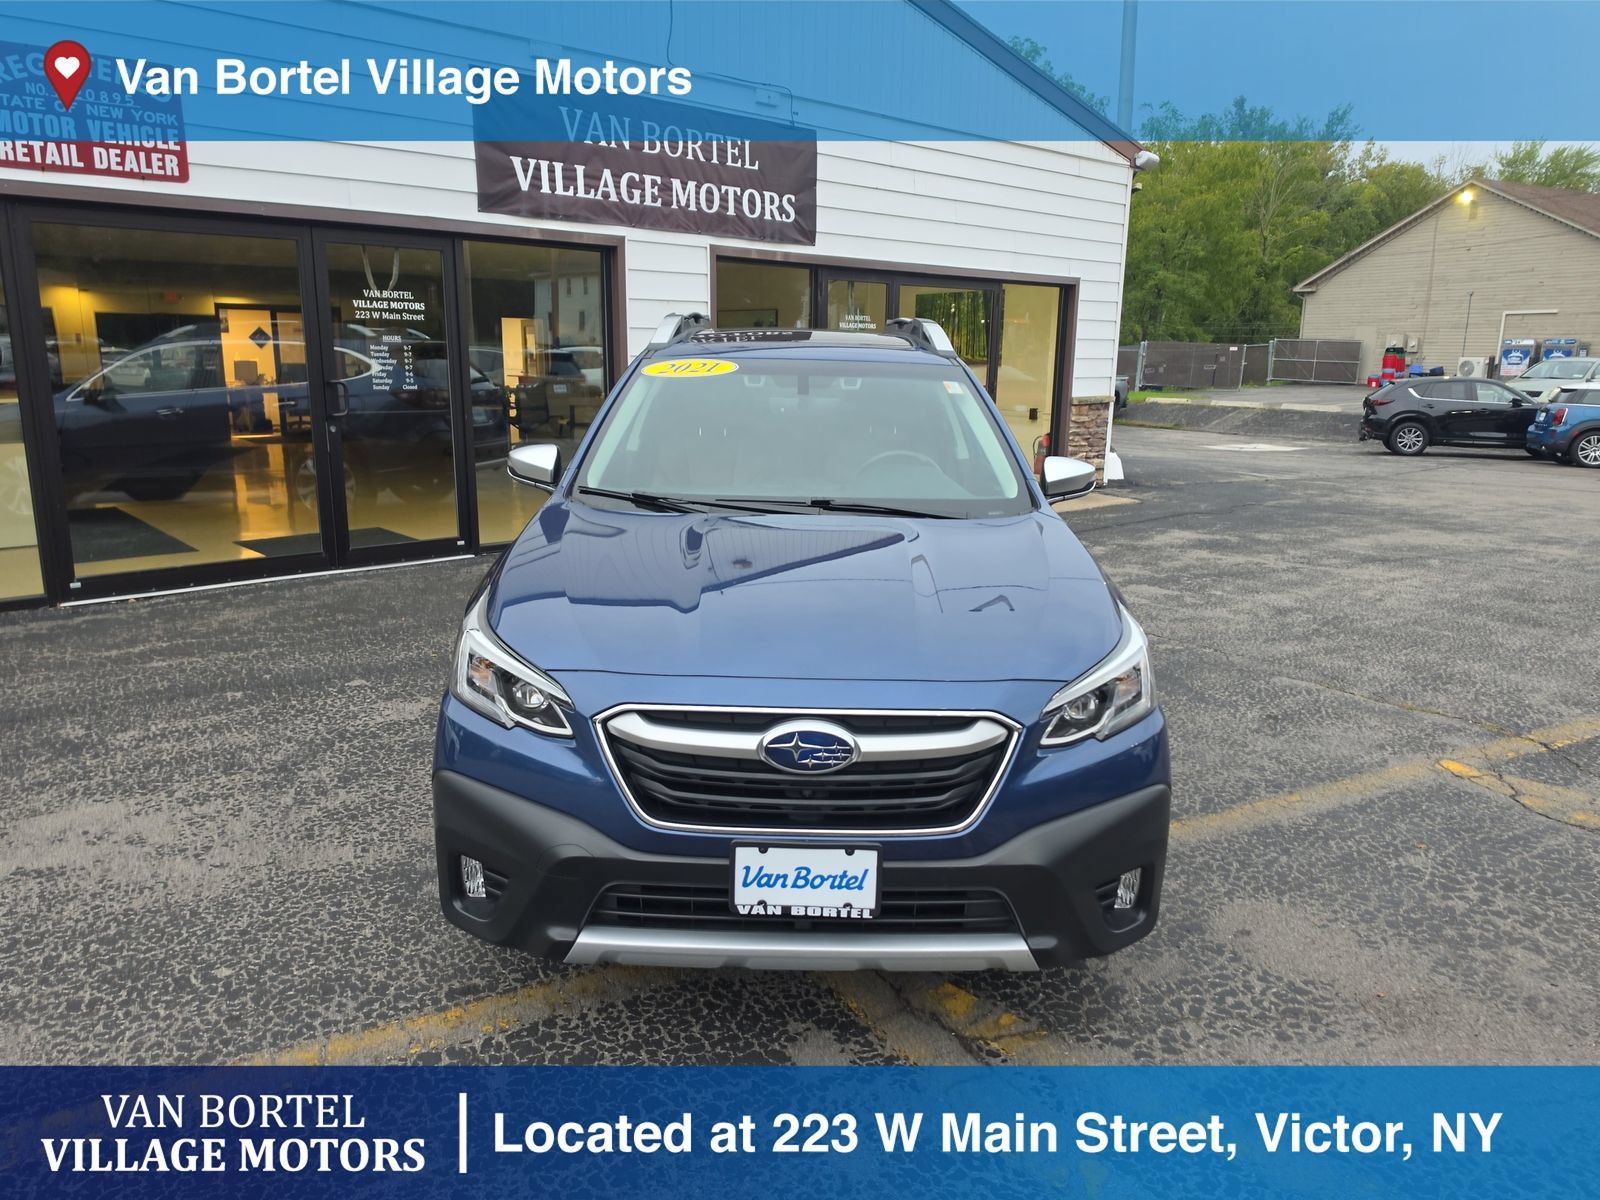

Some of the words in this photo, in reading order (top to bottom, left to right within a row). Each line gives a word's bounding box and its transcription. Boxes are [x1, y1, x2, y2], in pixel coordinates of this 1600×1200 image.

[0, 93, 46, 110] TATE
[86, 103, 123, 119] NEW
[131, 109, 179, 126] YORK
[86, 119, 181, 151] VEHICLE
[559, 106, 631, 150] VAN
[641, 119, 760, 171] BORTEL
[0, 137, 84, 168] RETAIL
[93, 146, 180, 177] DEALER
[509, 156, 663, 208] VILLAGE
[670, 177, 797, 223] MOTORS
[353, 299, 389, 309] VILLAGE
[390, 301, 425, 311] MOTORS
[363, 289, 381, 298] VAN
[382, 290, 414, 300] BORTEL
[355, 310, 371, 319] 223
[371, 311, 381, 319] W
[382, 312, 401, 320] Main
[402, 312, 425, 321] Street
[657, 362, 721, 374] 2021
[742, 865, 789, 889] Van
[790, 866, 869, 891] Bortel
[736, 904, 782, 916] VAN
[791, 905, 873, 919] BORTEL
